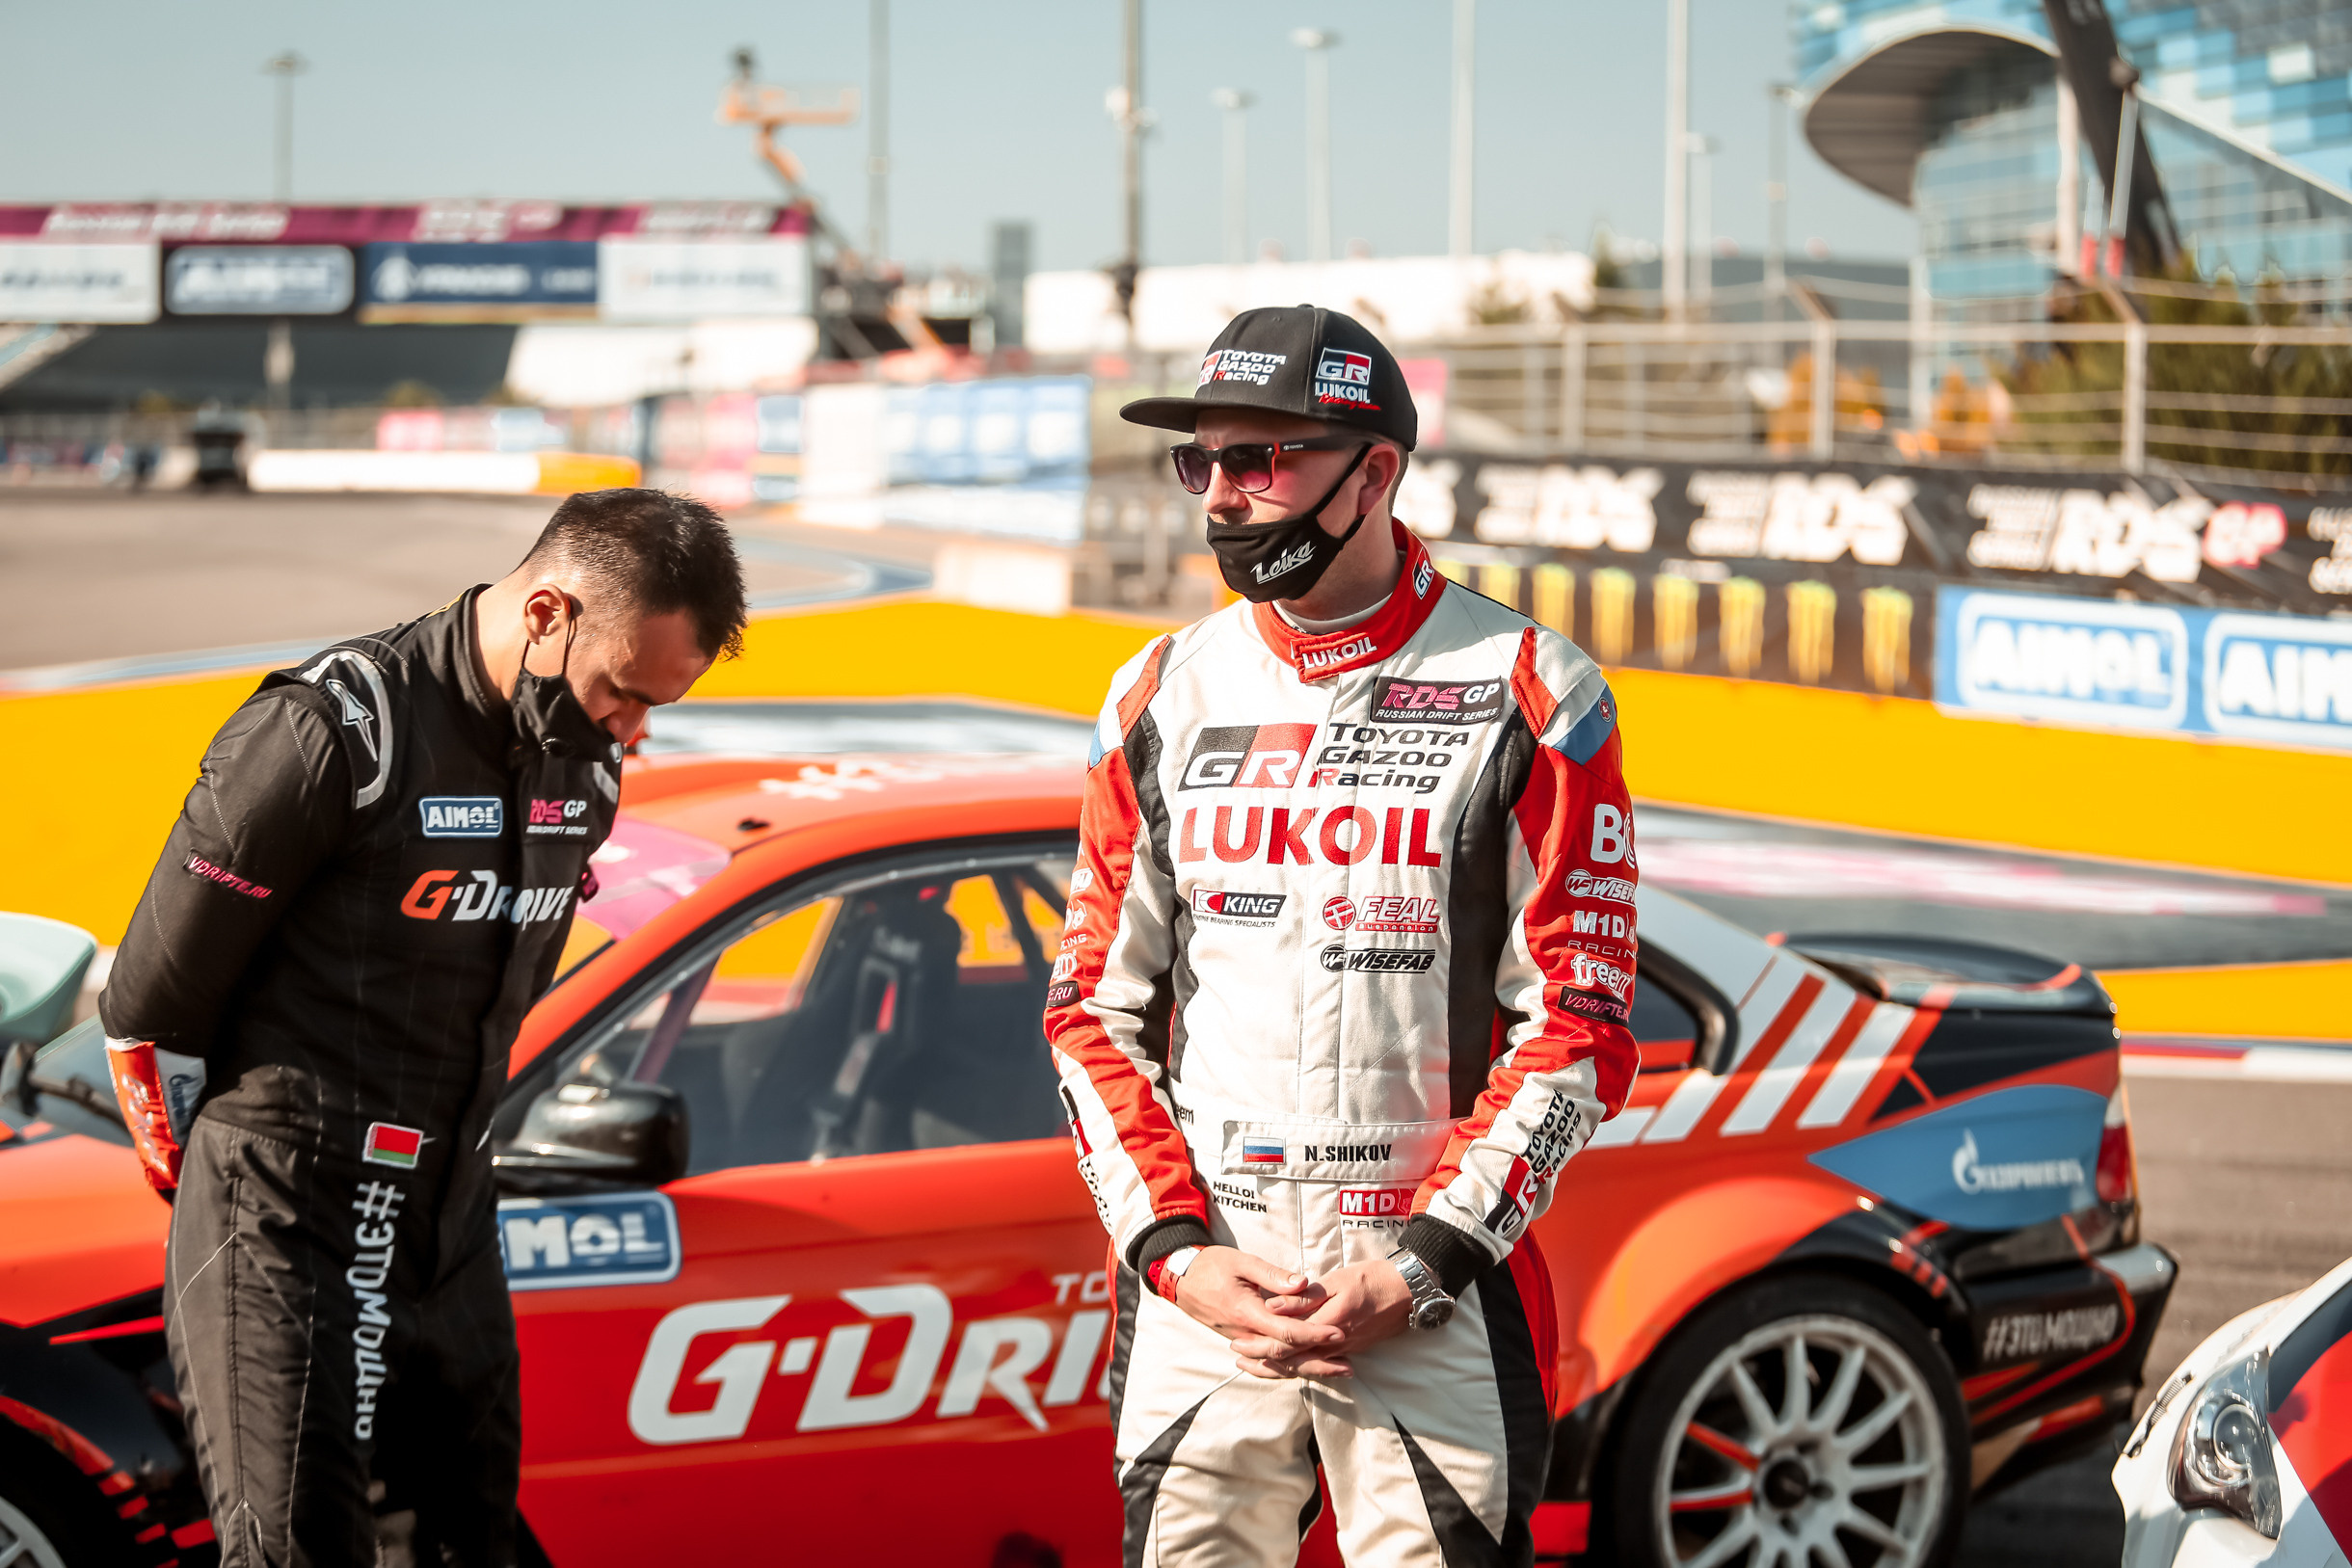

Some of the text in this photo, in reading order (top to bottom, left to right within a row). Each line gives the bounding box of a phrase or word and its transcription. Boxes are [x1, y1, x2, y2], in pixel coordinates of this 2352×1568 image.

[1217, 360, 1276, 374] GAZOO
[1222, 349, 1287, 365] TOYOTA
[1214, 369, 1270, 385] Racing
[1318, 359, 1369, 383] GR
[1315, 382, 1371, 404] LUKOIL
[2051, 488, 2215, 584] RDS
[2204, 500, 2288, 569] GP
[1415, 559, 1434, 597] GR
[1302, 636, 1377, 669] LUKOIL
[1972, 619, 2170, 699] AIMOL
[1381, 682, 1500, 710] RDS GP
[1376, 707, 1499, 721] RUSSIAN DRIFT SERIES
[1329, 723, 1470, 747] TOYOTA
[1183, 749, 1304, 788] GR
[1320, 746, 1452, 767] GAZOO
[1307, 768, 1441, 794] Racing
[427, 806, 499, 829] AIMOL
[563, 799, 588, 818] GP
[1178, 805, 1443, 867] LUKOIL
[188, 856, 273, 899] VDRIFTE.RU
[1222, 894, 1281, 915] KING
[1357, 895, 1441, 923] FEAL
[1210, 917, 1234, 925] BEARING
[1234, 919, 1276, 928] SPECIALISTS
[1349, 951, 1435, 970] WISEFAB
[1567, 940, 1638, 962] RACIN
[1564, 994, 1629, 1022] VDRIFTE.R
[1521, 1088, 1565, 1162] TOYOTA
[1532, 1099, 1576, 1175] GAZOO
[1304, 1143, 1392, 1163] N.SHIKOV
[1537, 1111, 1582, 1184] Racing
[1213, 1195, 1268, 1213] KITCHEN
[1495, 1172, 1540, 1239] GR
[1343, 1219, 1409, 1229] RACIN
[503, 1212, 665, 1270] MOL
[345, 1181, 406, 1441] #ЭТОМОЩНО
[628, 1284, 1109, 1445] G-DRI
